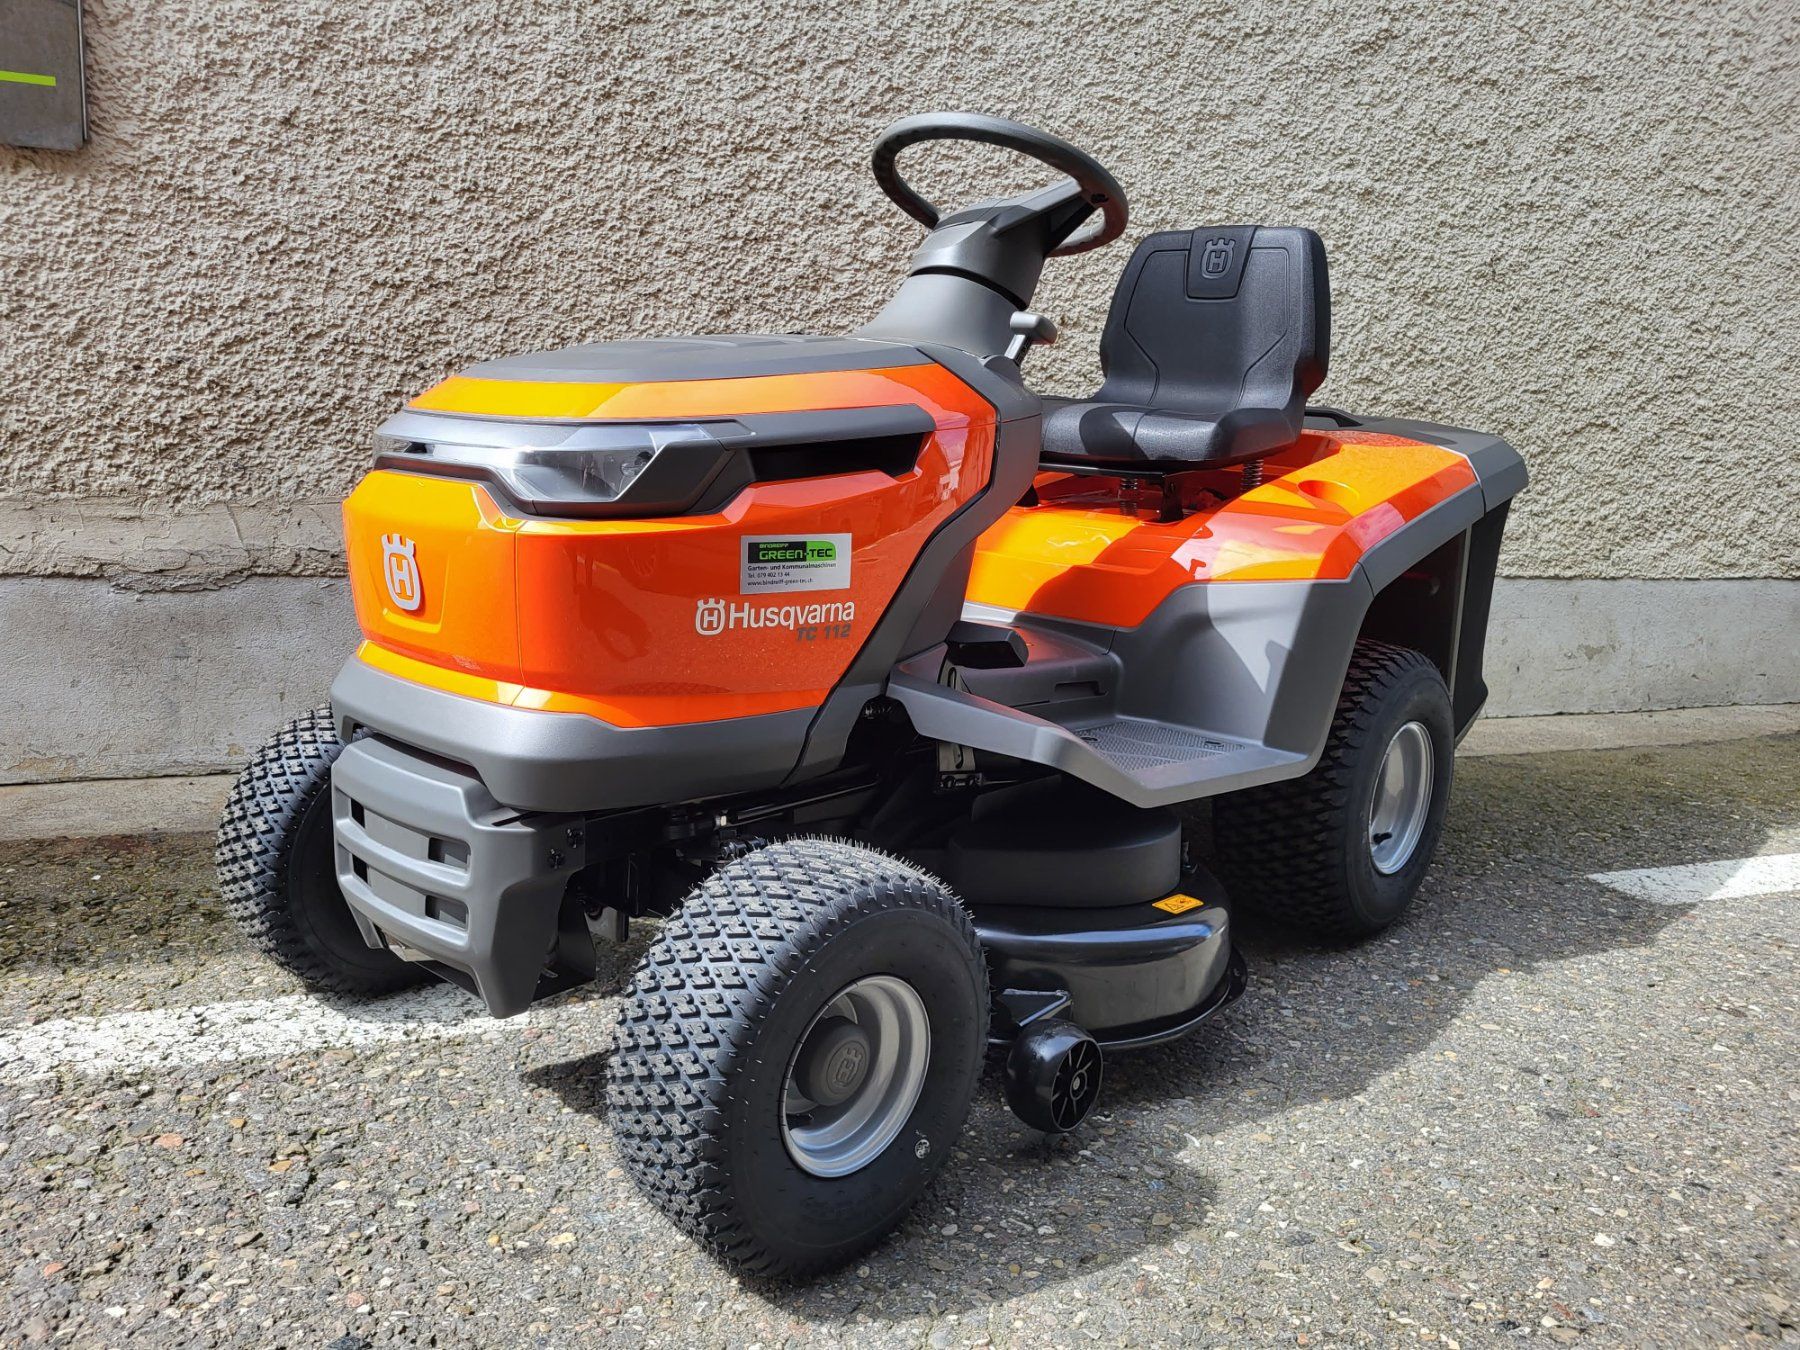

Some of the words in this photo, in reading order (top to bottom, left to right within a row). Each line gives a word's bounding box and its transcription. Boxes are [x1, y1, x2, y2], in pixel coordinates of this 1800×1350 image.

[781, 562, 837, 570] Kommunalmaschinen
[728, 601, 855, 630] Husqvarna
[796, 627, 816, 640] TC
[823, 624, 851, 640] 112
